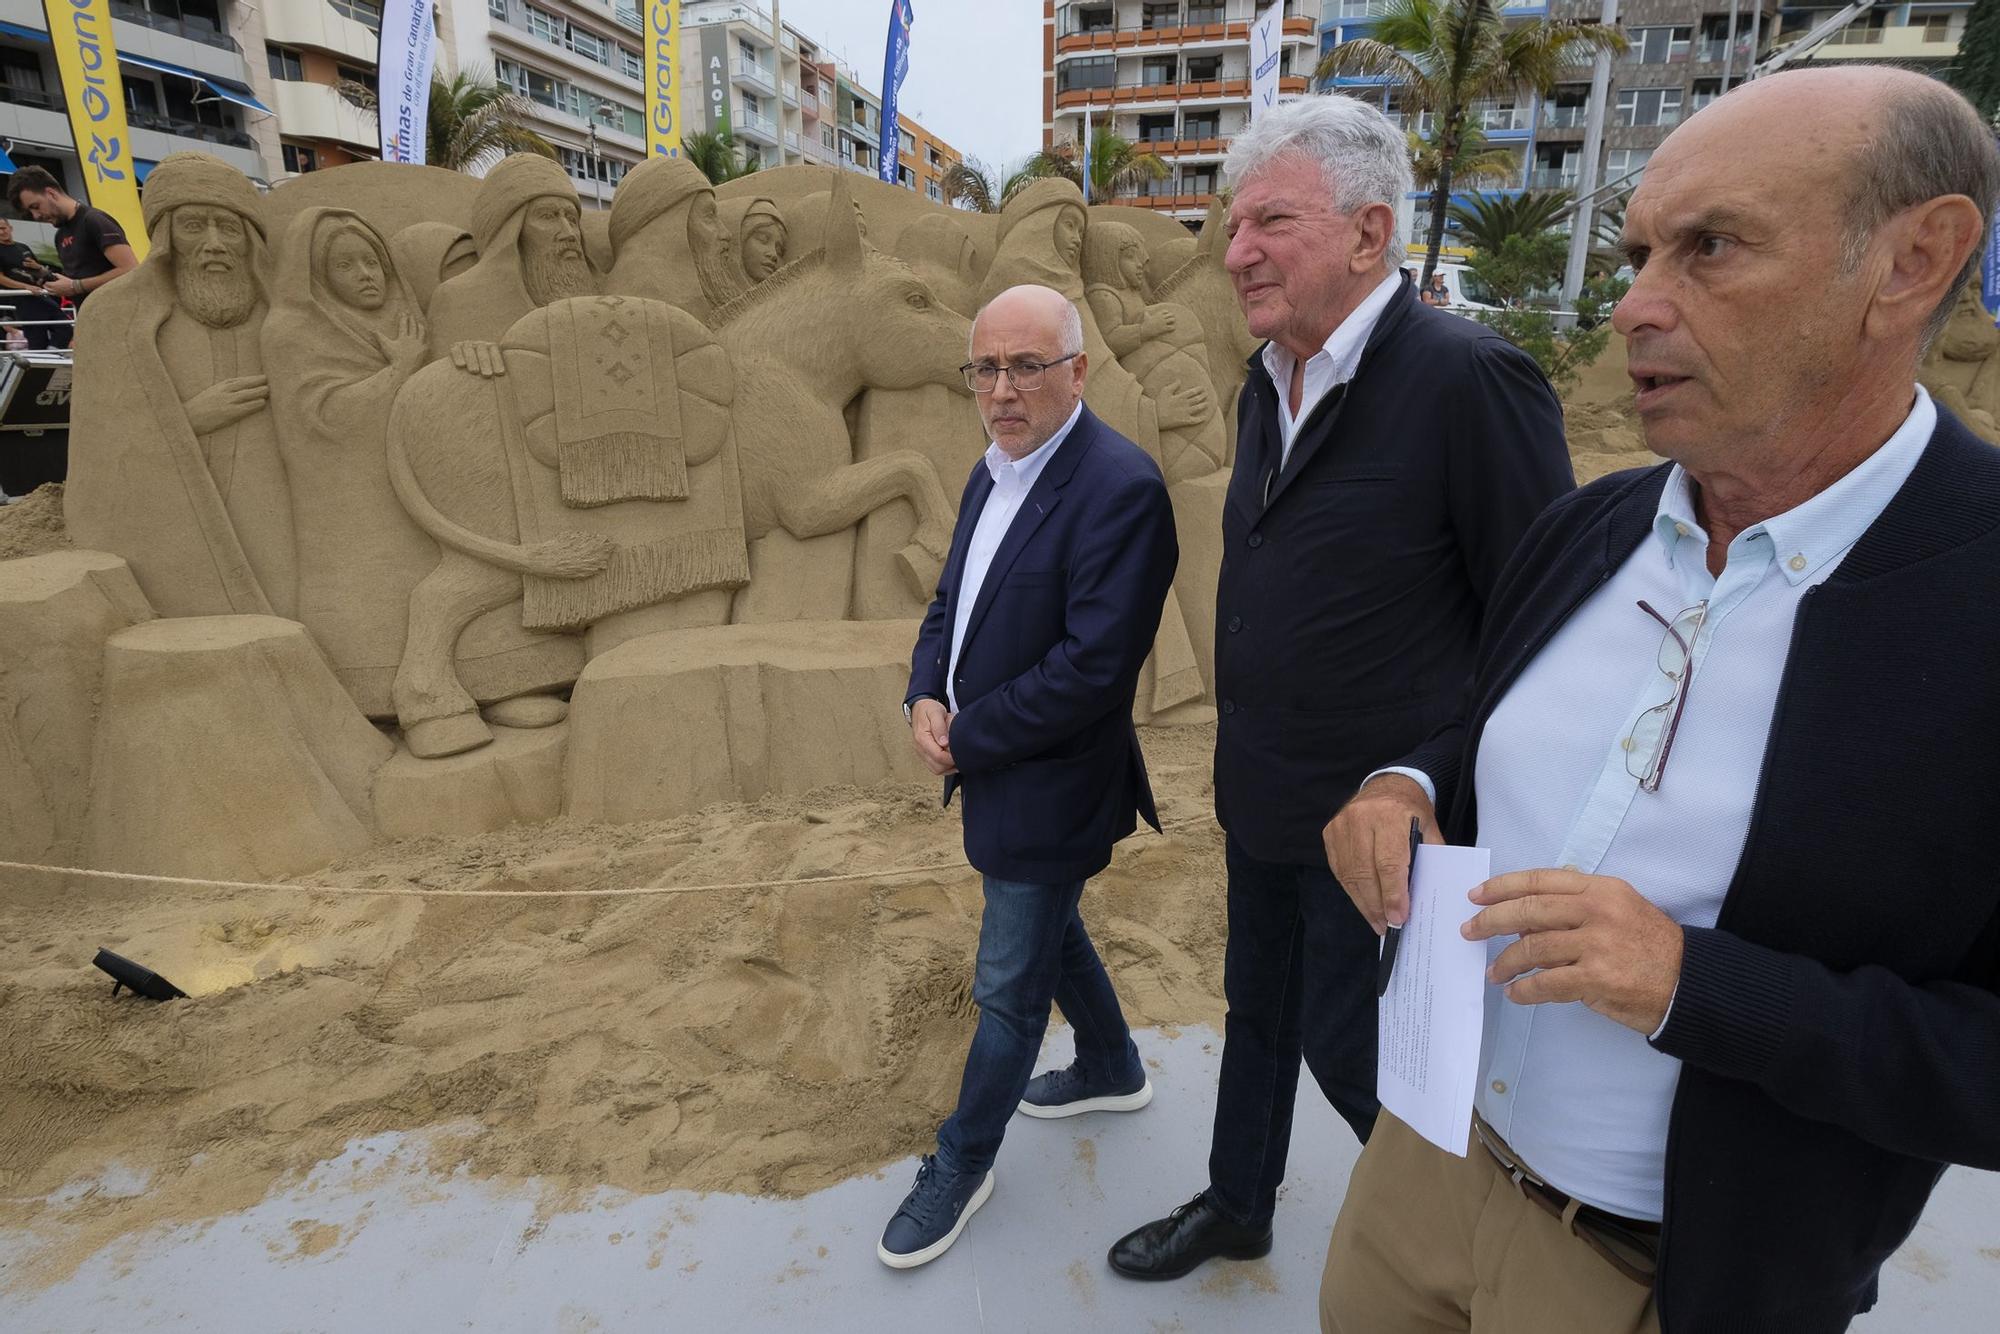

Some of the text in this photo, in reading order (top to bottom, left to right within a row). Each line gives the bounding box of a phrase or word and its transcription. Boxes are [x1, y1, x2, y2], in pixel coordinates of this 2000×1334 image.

[404, 50, 414, 81] Gran
[710, 56, 723, 117] ALOE
[403, 84, 412, 102] de
[399, 104, 411, 163] almas
